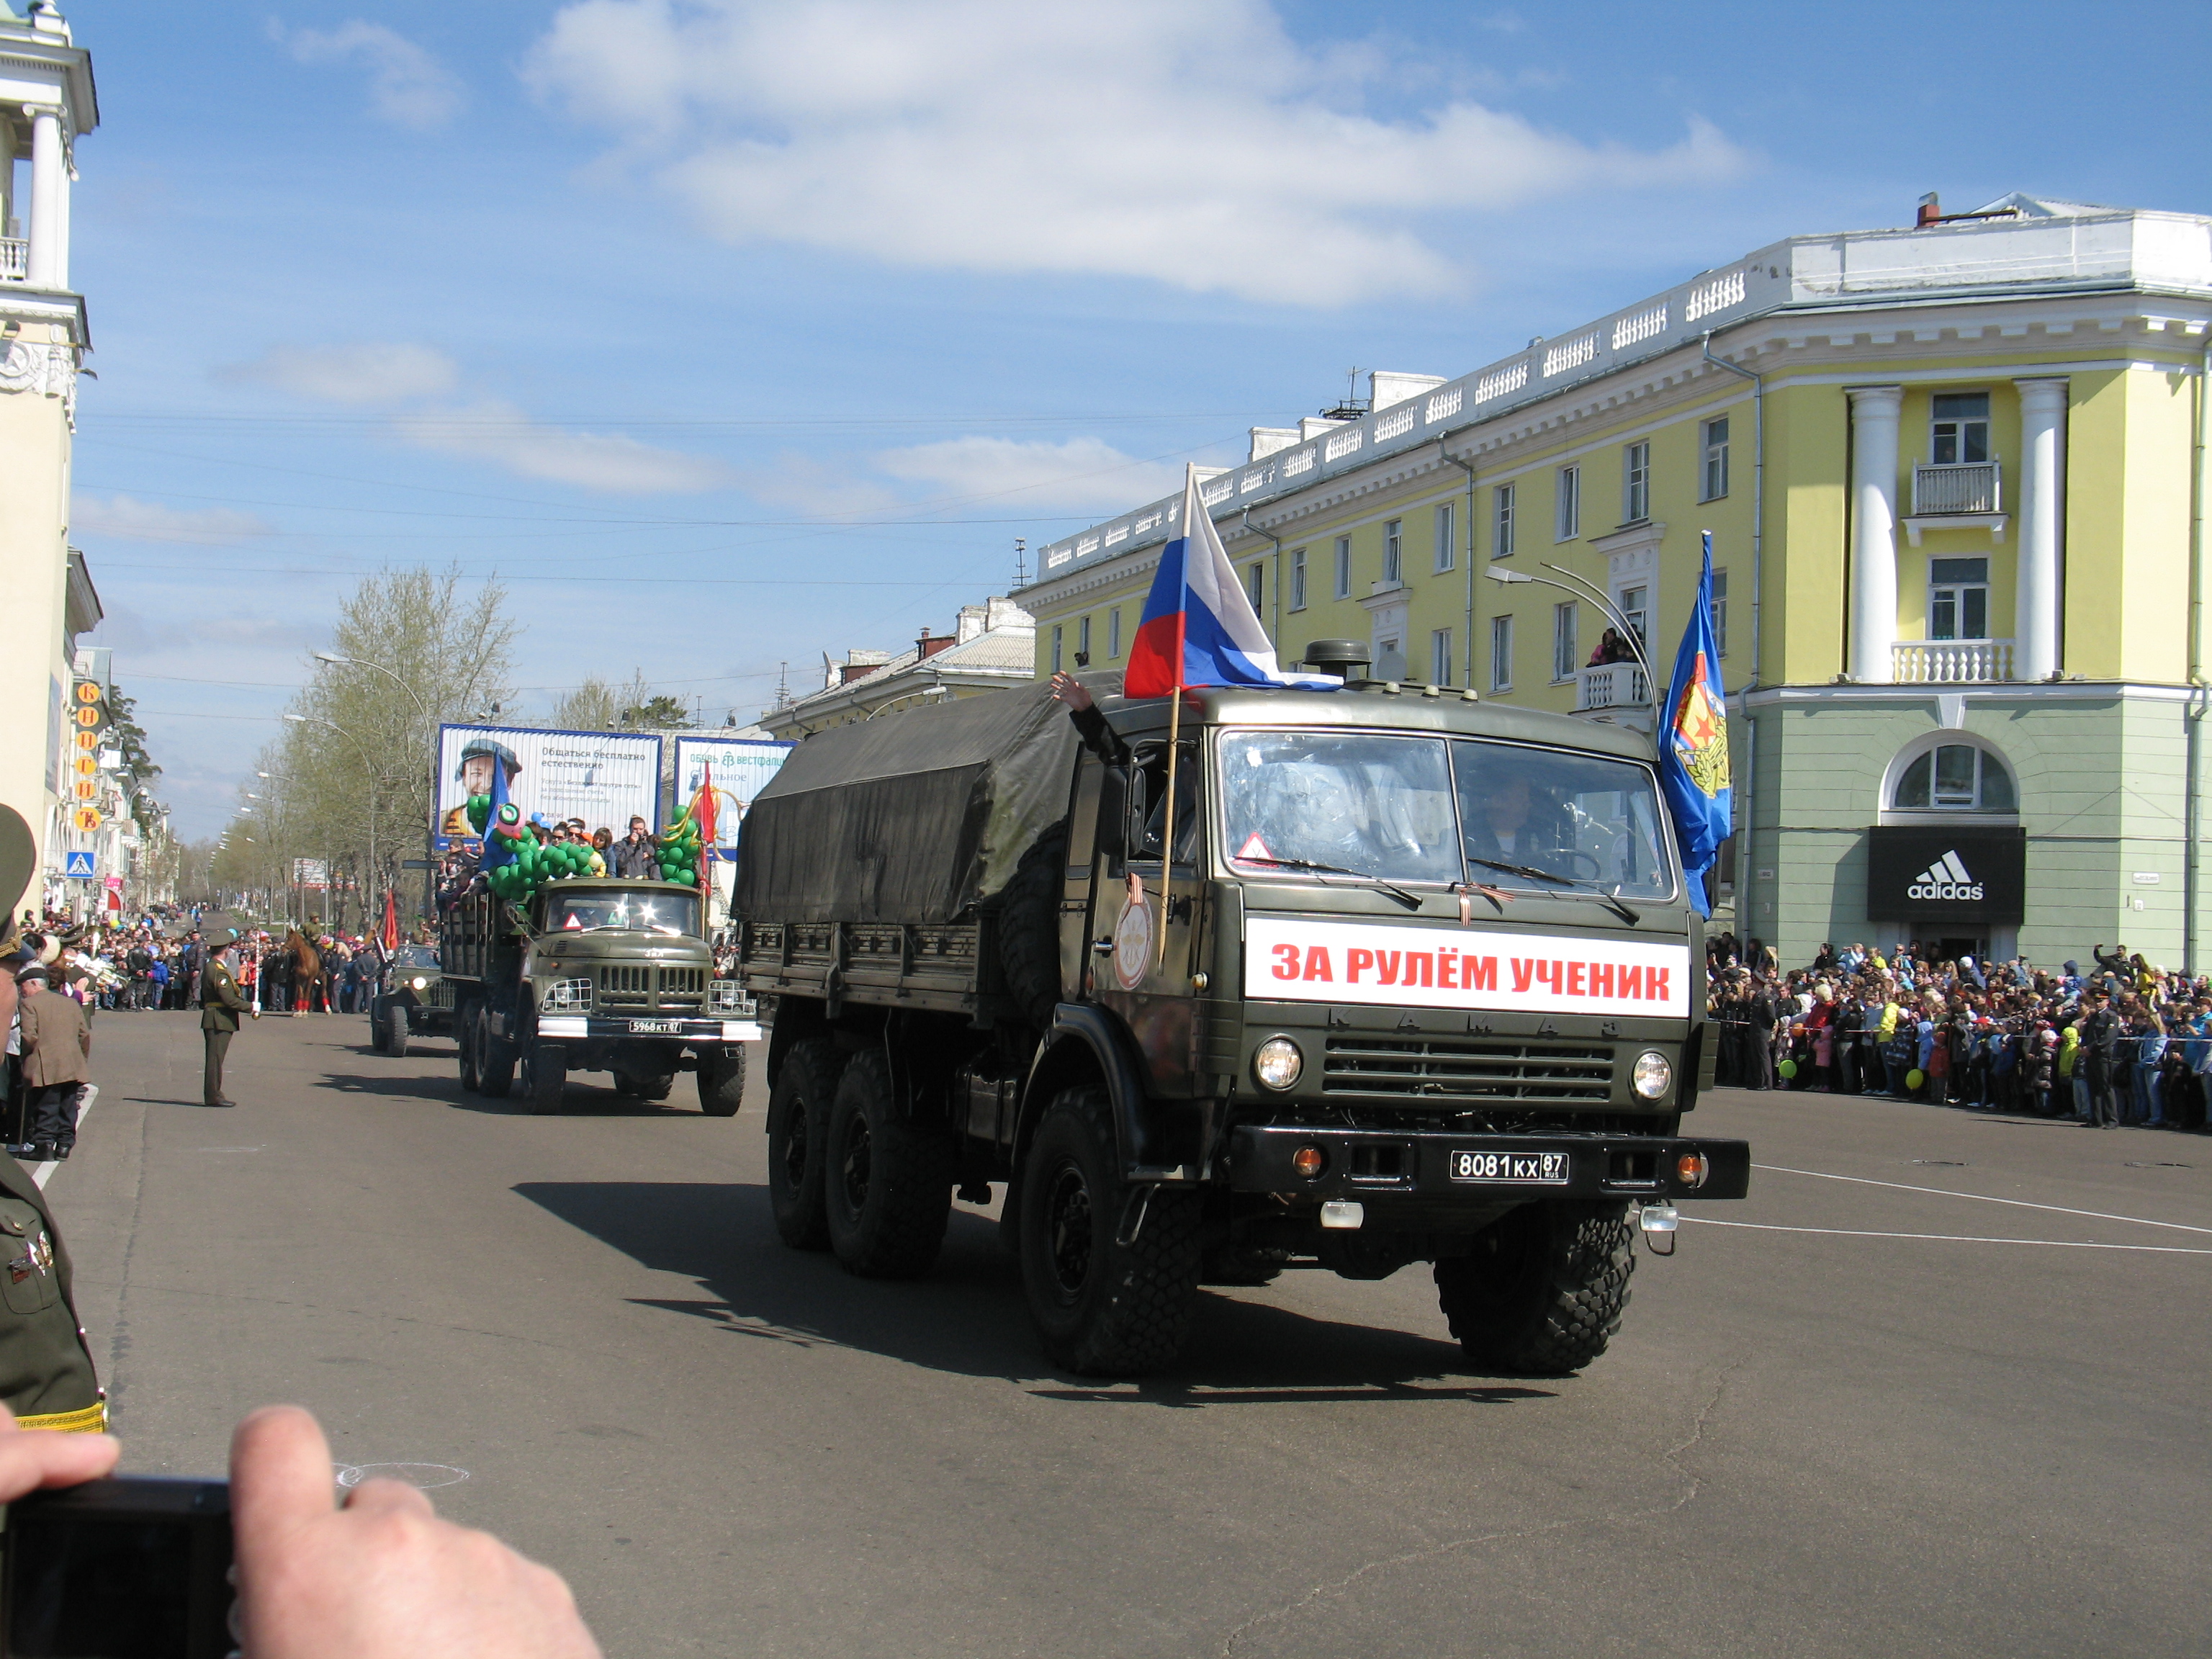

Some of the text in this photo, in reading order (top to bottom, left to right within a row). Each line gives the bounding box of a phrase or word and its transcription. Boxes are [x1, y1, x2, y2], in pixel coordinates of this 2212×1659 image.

[78, 685, 95, 796] КНИГИ
[542, 747, 646, 760] Общаться бесплатно
[541, 760, 603, 770] естественно
[690, 768, 747, 782] Стльное
[1907, 881, 1984, 901] adidas
[1271, 943, 1670, 1002] ЗА РУЛЁМ УЧЕНИК
[1326, 1007, 1622, 1037] КАМАЗ
[1542, 1154, 1563, 1172] 87
